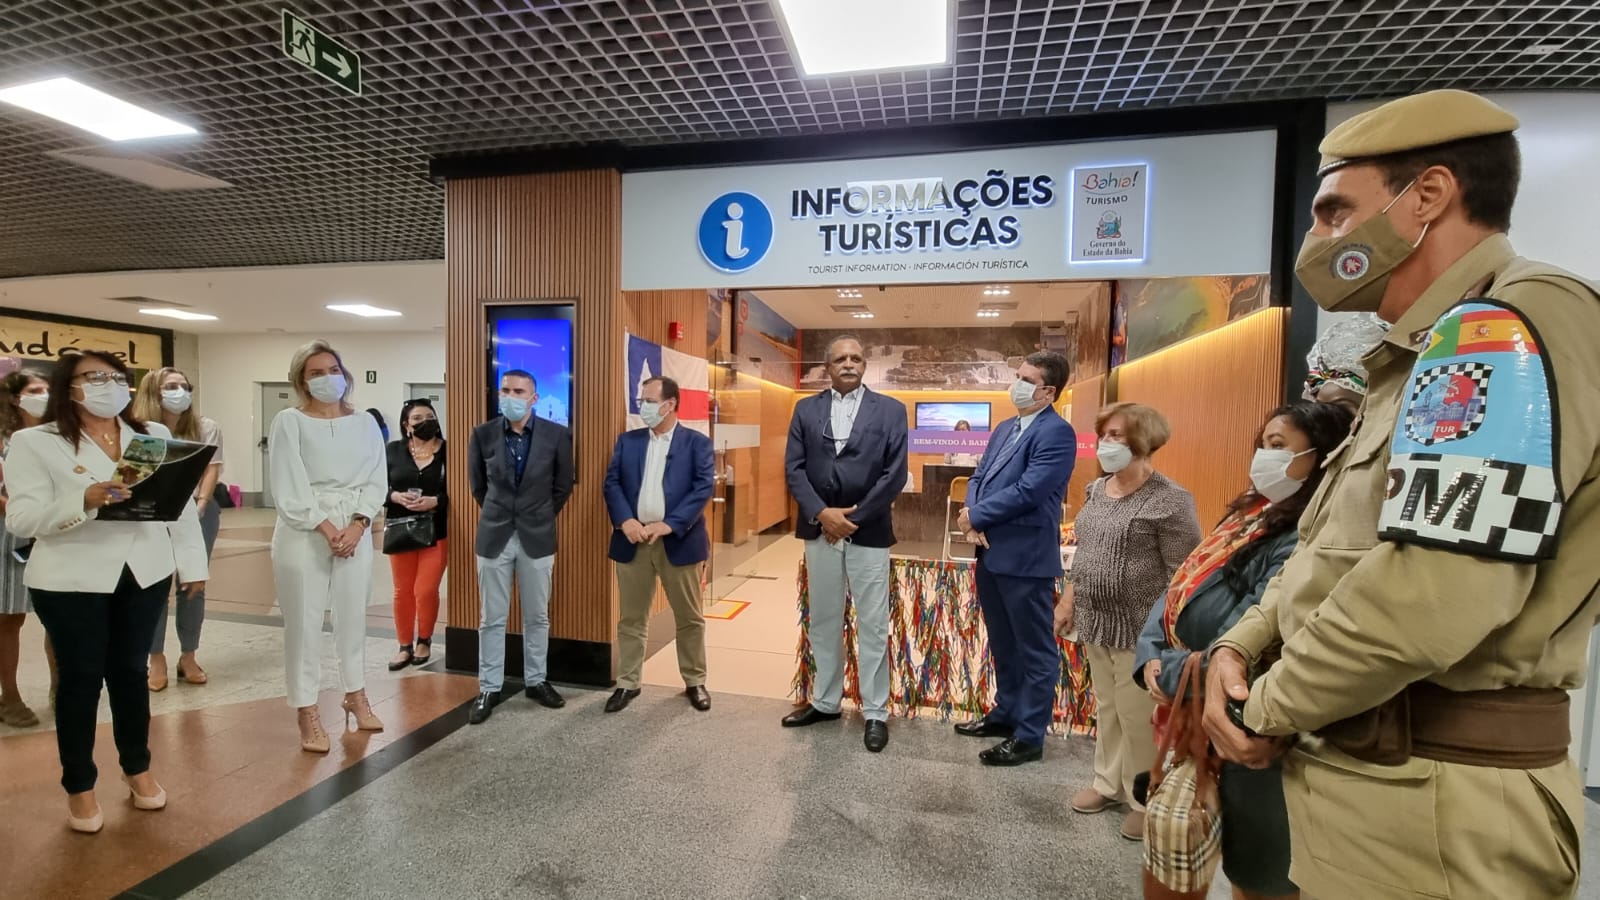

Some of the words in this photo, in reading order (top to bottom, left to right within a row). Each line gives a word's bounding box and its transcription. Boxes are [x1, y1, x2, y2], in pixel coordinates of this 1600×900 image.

[1082, 171, 1139, 190] Bahia!
[792, 169, 1053, 217] INFORMAÇÕES
[1086, 195, 1128, 205] TURISMO
[819, 213, 1018, 252] TURÍSTICAS
[1090, 240, 1116, 248] Governo
[1117, 239, 1126, 247] do
[1083, 248, 1104, 257] Estado
[1105, 248, 1113, 256] da
[1115, 247, 1133, 255] Bahia
[808, 264, 843, 274] TOURIST
[845, 263, 907, 273] INFORMATION
[913, 259, 979, 271] INFORMACIÓN
[982, 258, 1029, 270] TURÍSTICA
[913, 438, 960, 446] BEM-VINDO
